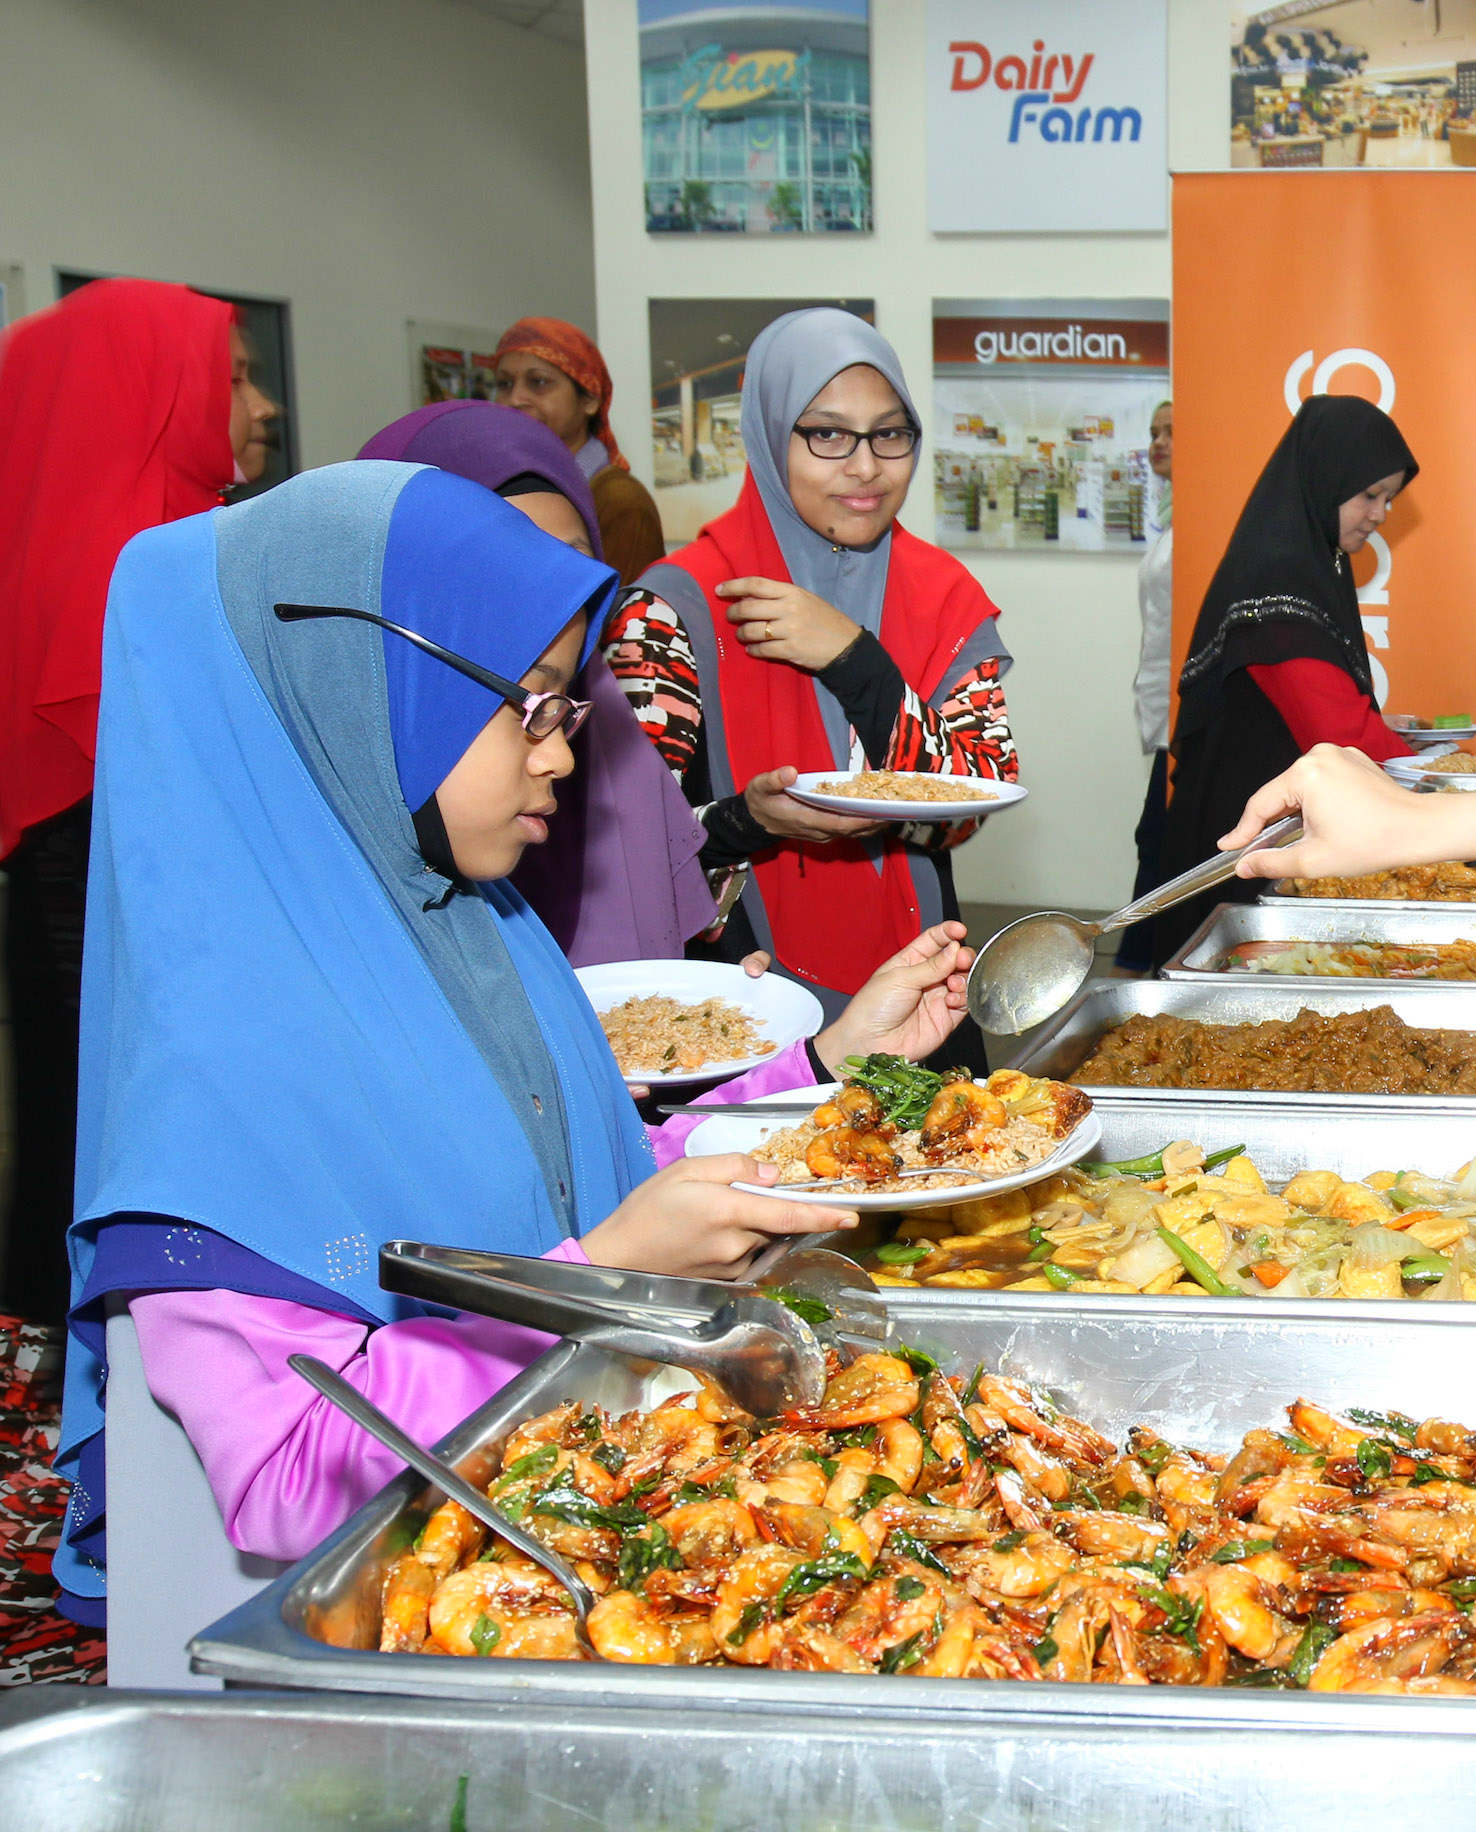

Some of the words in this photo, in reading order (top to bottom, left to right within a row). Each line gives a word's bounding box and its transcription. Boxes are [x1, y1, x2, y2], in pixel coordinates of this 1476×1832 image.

[678, 42, 812, 115] Giant
[948, 38, 1095, 103] Dairy
[1008, 92, 1142, 143] Farm
[974, 325, 1126, 364] guardian
